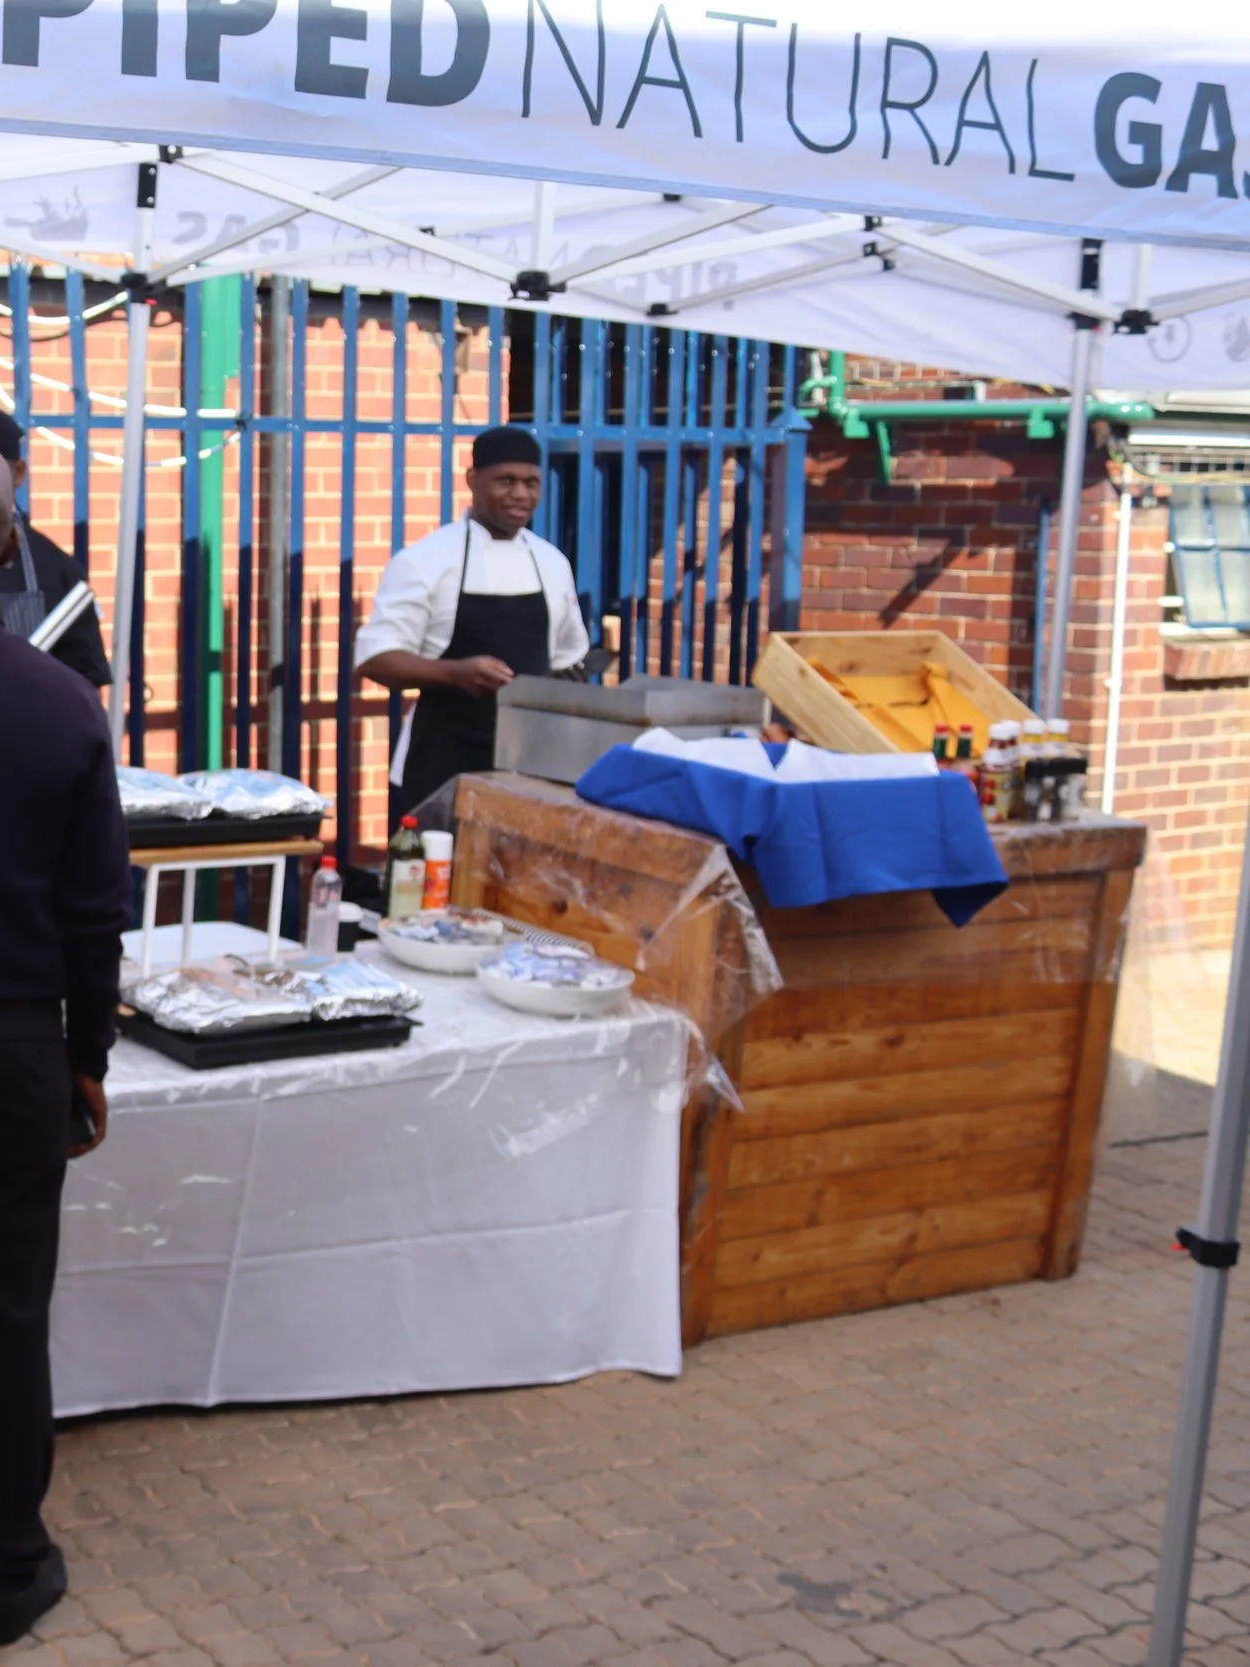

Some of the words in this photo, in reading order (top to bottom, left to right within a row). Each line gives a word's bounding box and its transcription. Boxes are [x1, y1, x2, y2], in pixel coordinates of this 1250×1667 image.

[2, 0, 490, 107] PIPED
[522, 0, 1075, 182] NATURAL
[1094, 71, 1250, 200] GA
